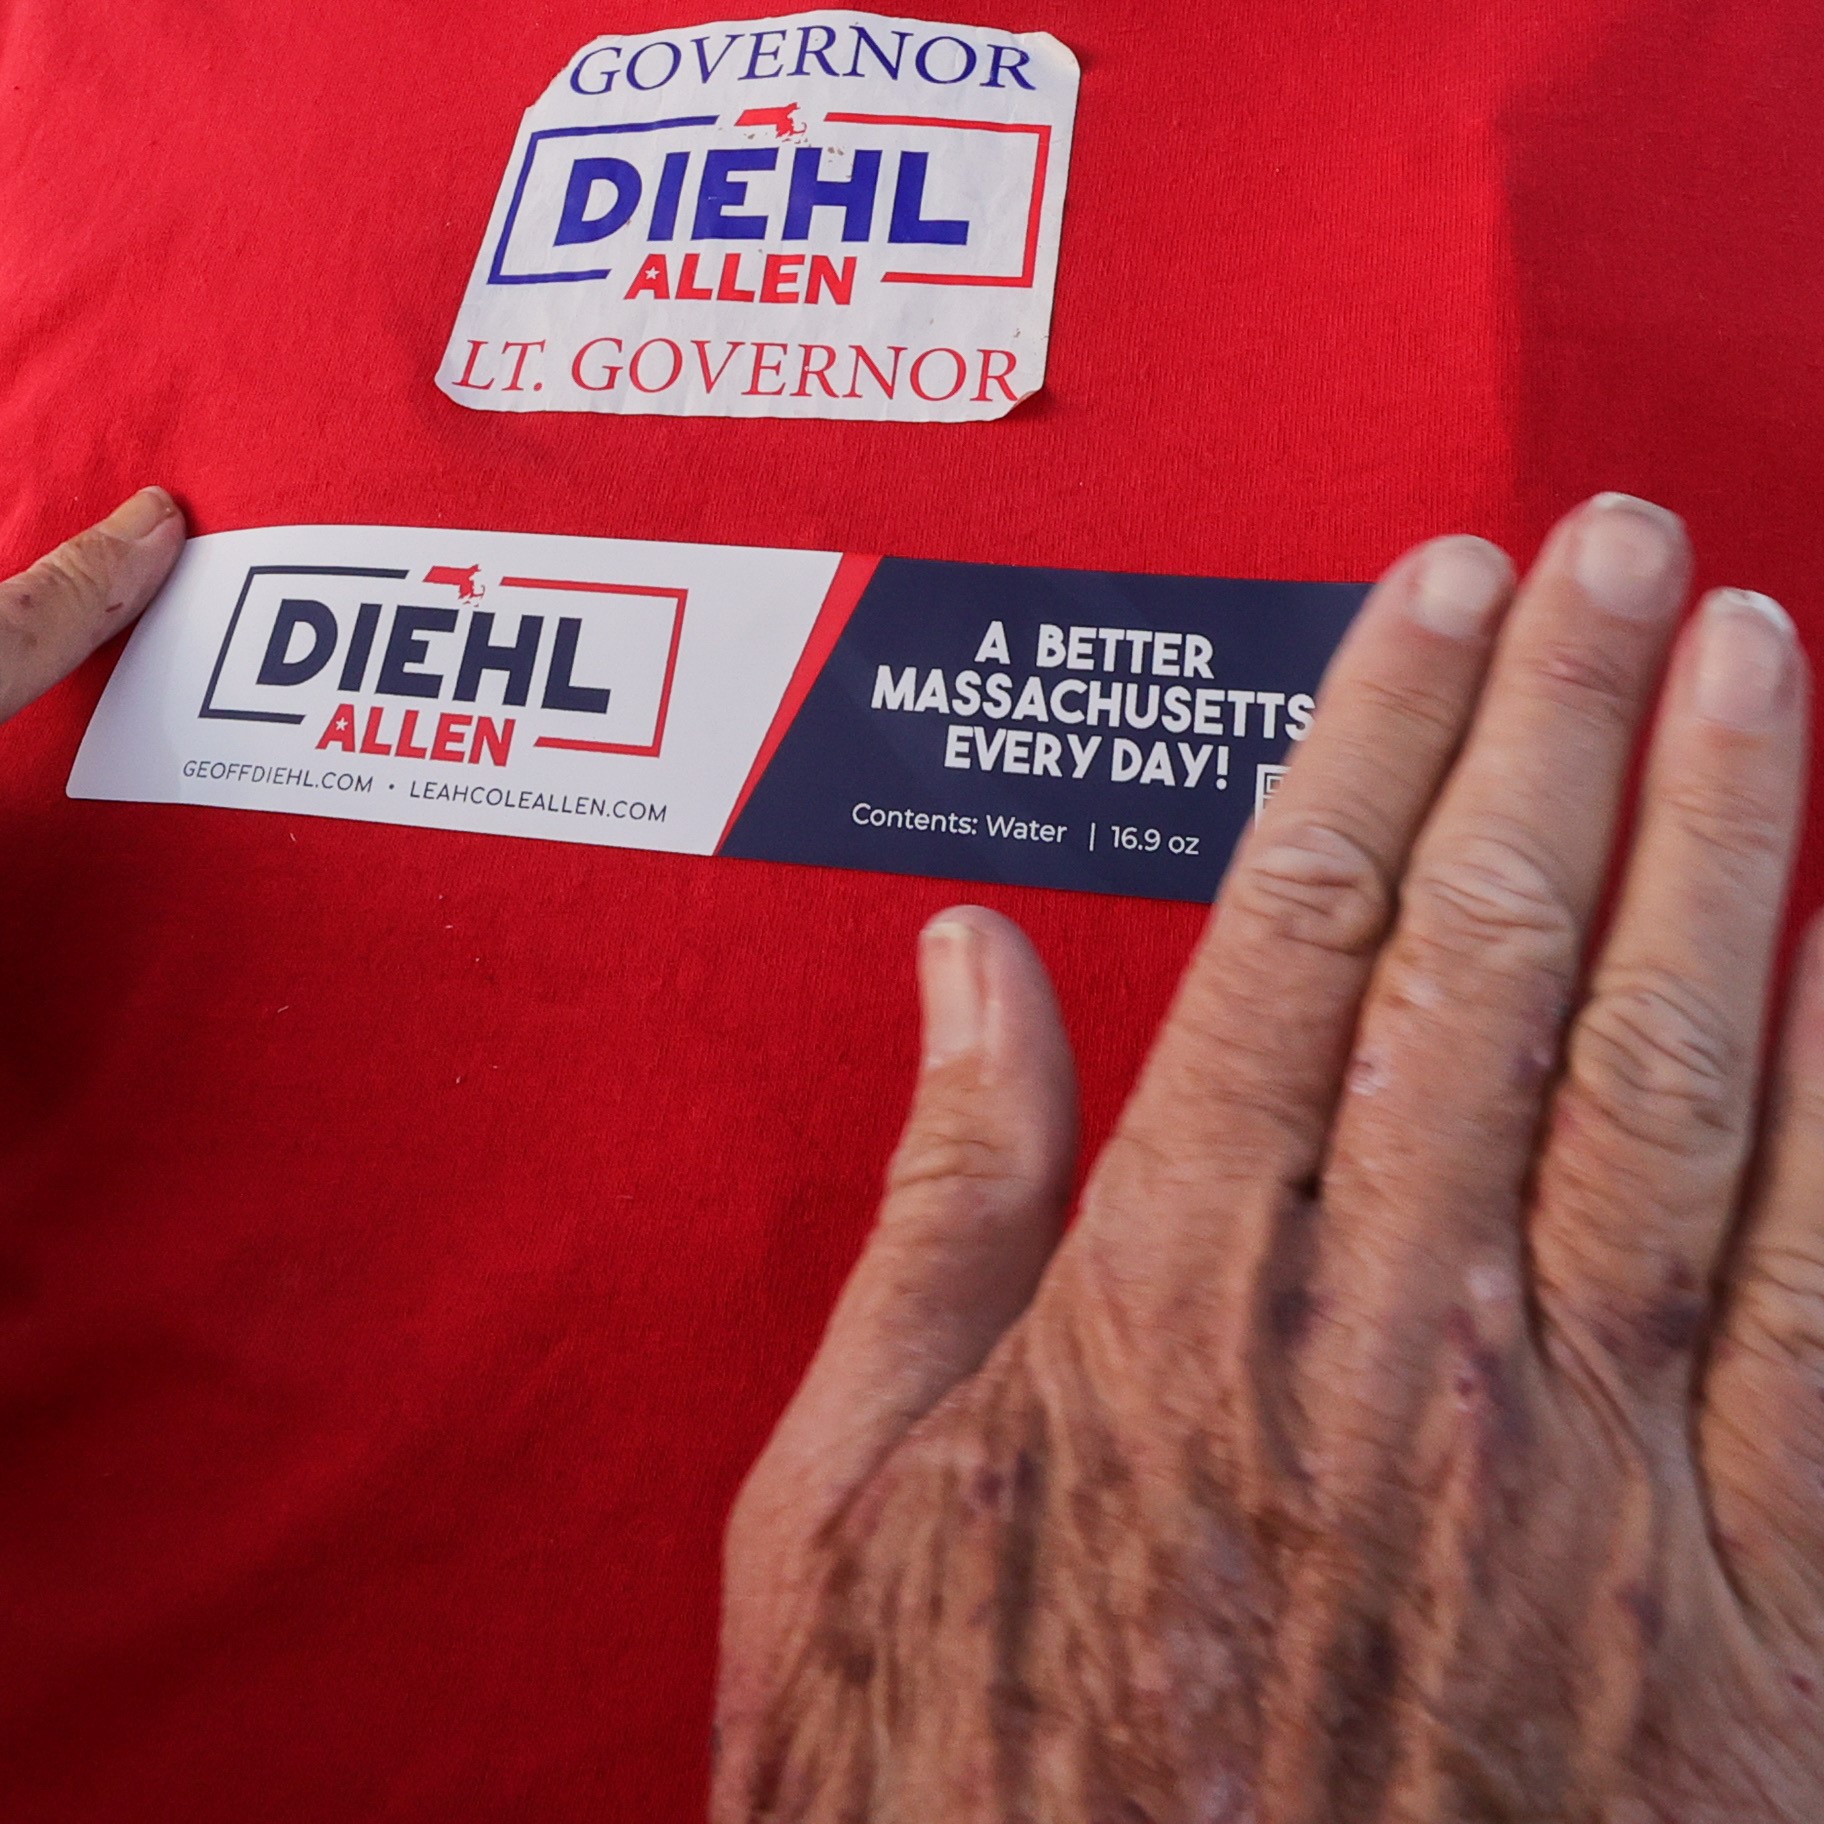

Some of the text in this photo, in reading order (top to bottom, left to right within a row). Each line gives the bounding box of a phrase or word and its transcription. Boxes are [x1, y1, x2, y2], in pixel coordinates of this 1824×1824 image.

[568, 25, 1037, 96] GOVERNOR
[552, 146, 969, 246] DIEHL
[623, 253, 858, 306] ALLEN
[452, 337, 1019, 403] LT. GOVERNOR
[255, 598, 611, 714] DIEHL
[974, 620, 1215, 679] A BETTER
[315, 703, 516, 768] ALLEN
[871, 665, 1317, 741] MASSACHUSETTS
[183, 759, 669, 823] GEOFFDIEHL.COM LEAHCOLEALLEN.COM
[943, 725, 1230, 791] EVERY DAY!
[851, 803, 1200, 856] Contents: Water 16.9 oz
